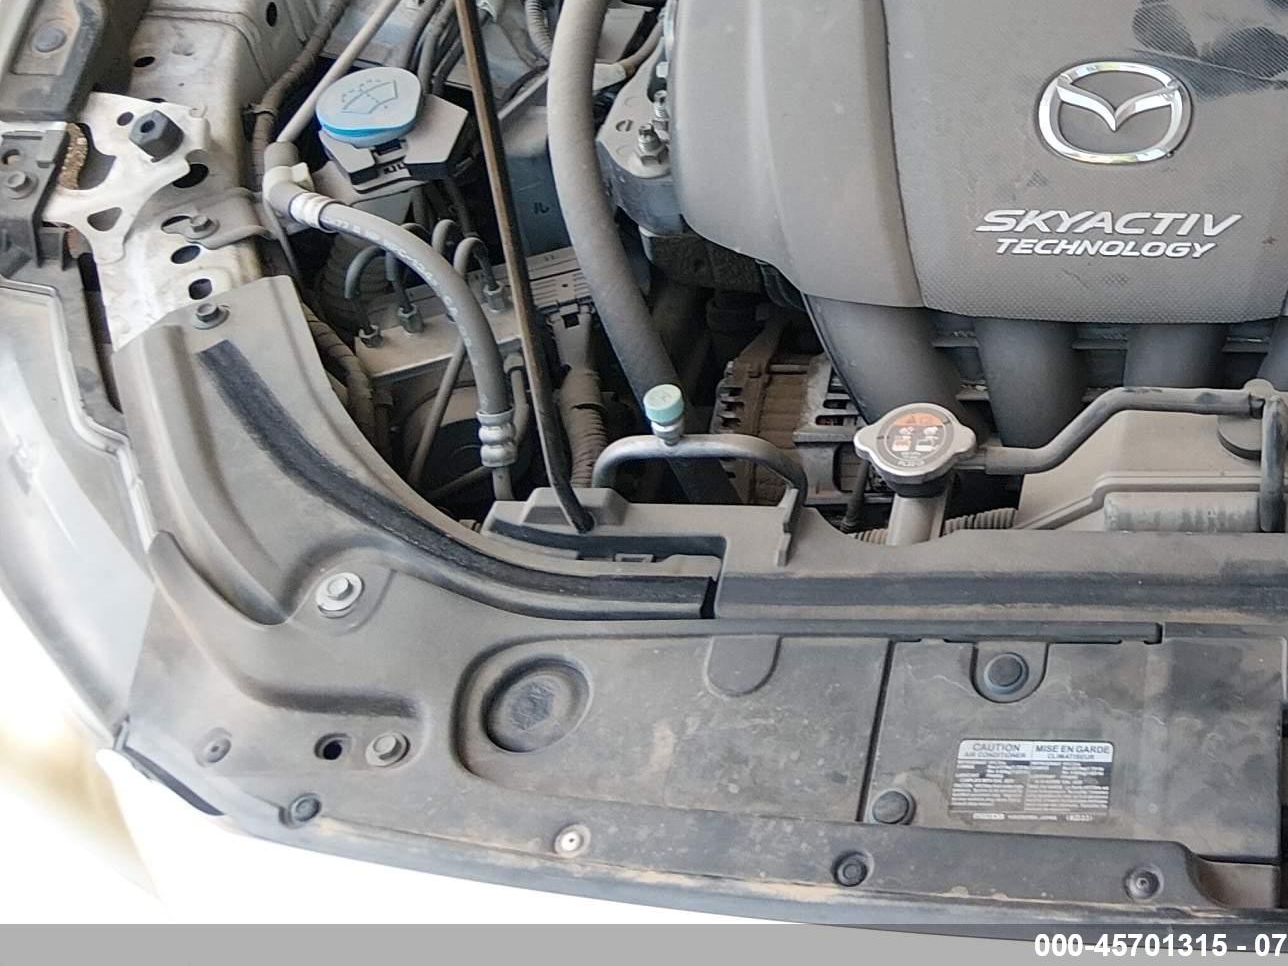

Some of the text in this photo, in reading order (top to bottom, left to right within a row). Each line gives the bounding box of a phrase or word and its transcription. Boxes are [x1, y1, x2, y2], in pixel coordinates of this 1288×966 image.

[975, 209, 1242, 236] SKYACTIV
[995, 237, 1216, 258] TECHNOLOGY
[972, 743, 1021, 752] CAUTION
[1035, 744, 1110, 754] MISE EN GARDE
